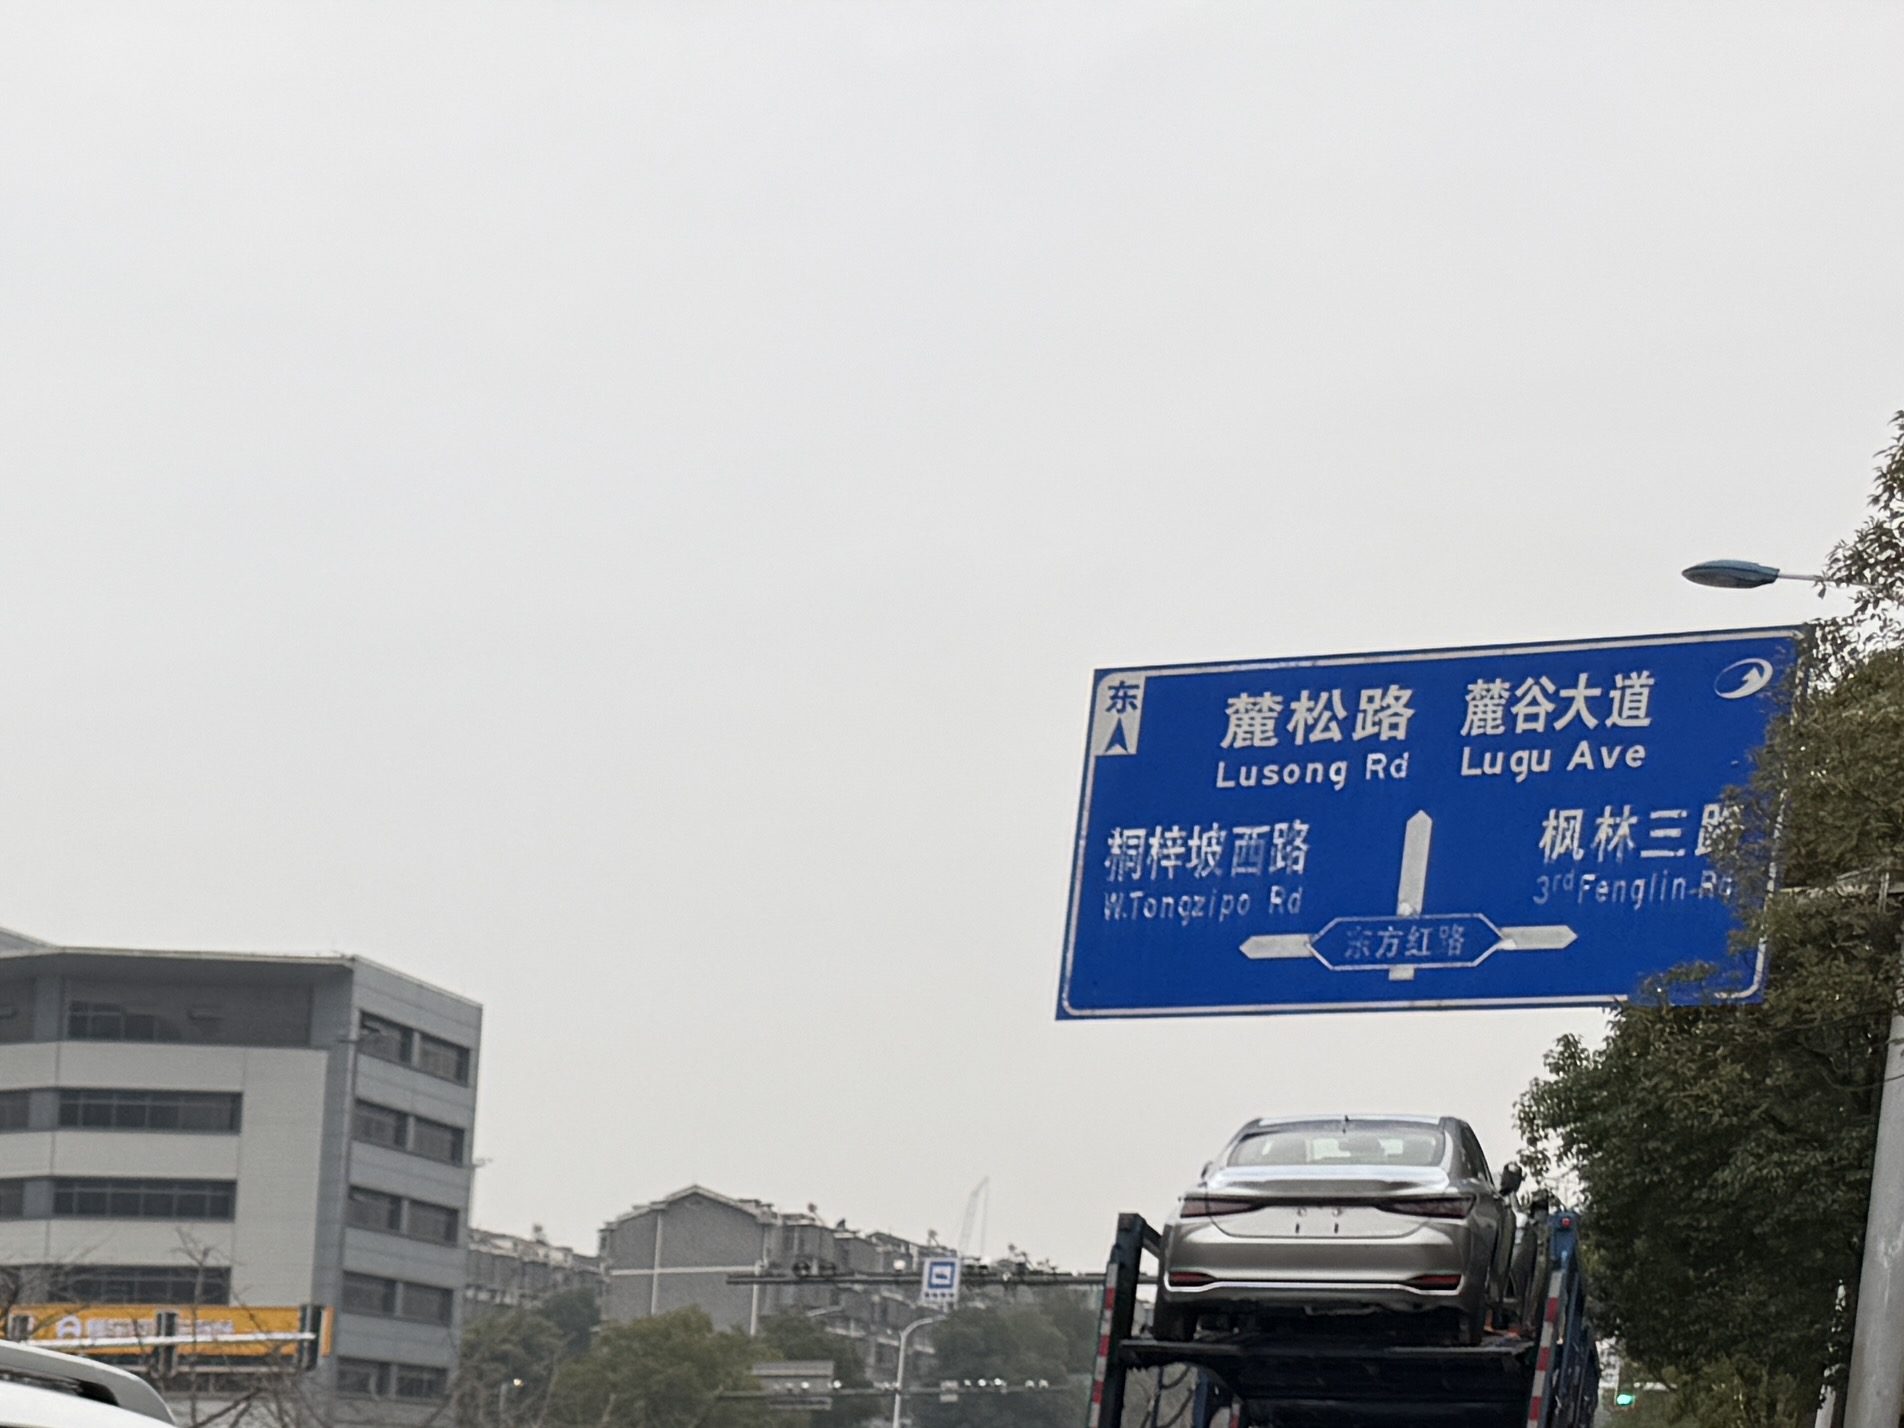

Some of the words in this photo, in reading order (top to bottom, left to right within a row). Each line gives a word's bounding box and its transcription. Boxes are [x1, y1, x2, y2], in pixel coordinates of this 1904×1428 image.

[1105, 680, 1139, 713] 东
[1220, 684, 1416, 749] 麓松路
[1460, 669, 1656, 737] 麓谷大道
[1216, 760, 1347, 791] Lusong
[1365, 751, 1409, 781] Rd
[1460, 746, 1552, 783] Lugu
[1566, 740, 1646, 771] Ave
[1103, 819, 1310, 882] 桐梓坡西路
[1268, 885, 1303, 915] Rd
[1345, 923, 1465, 959] 东方红路
